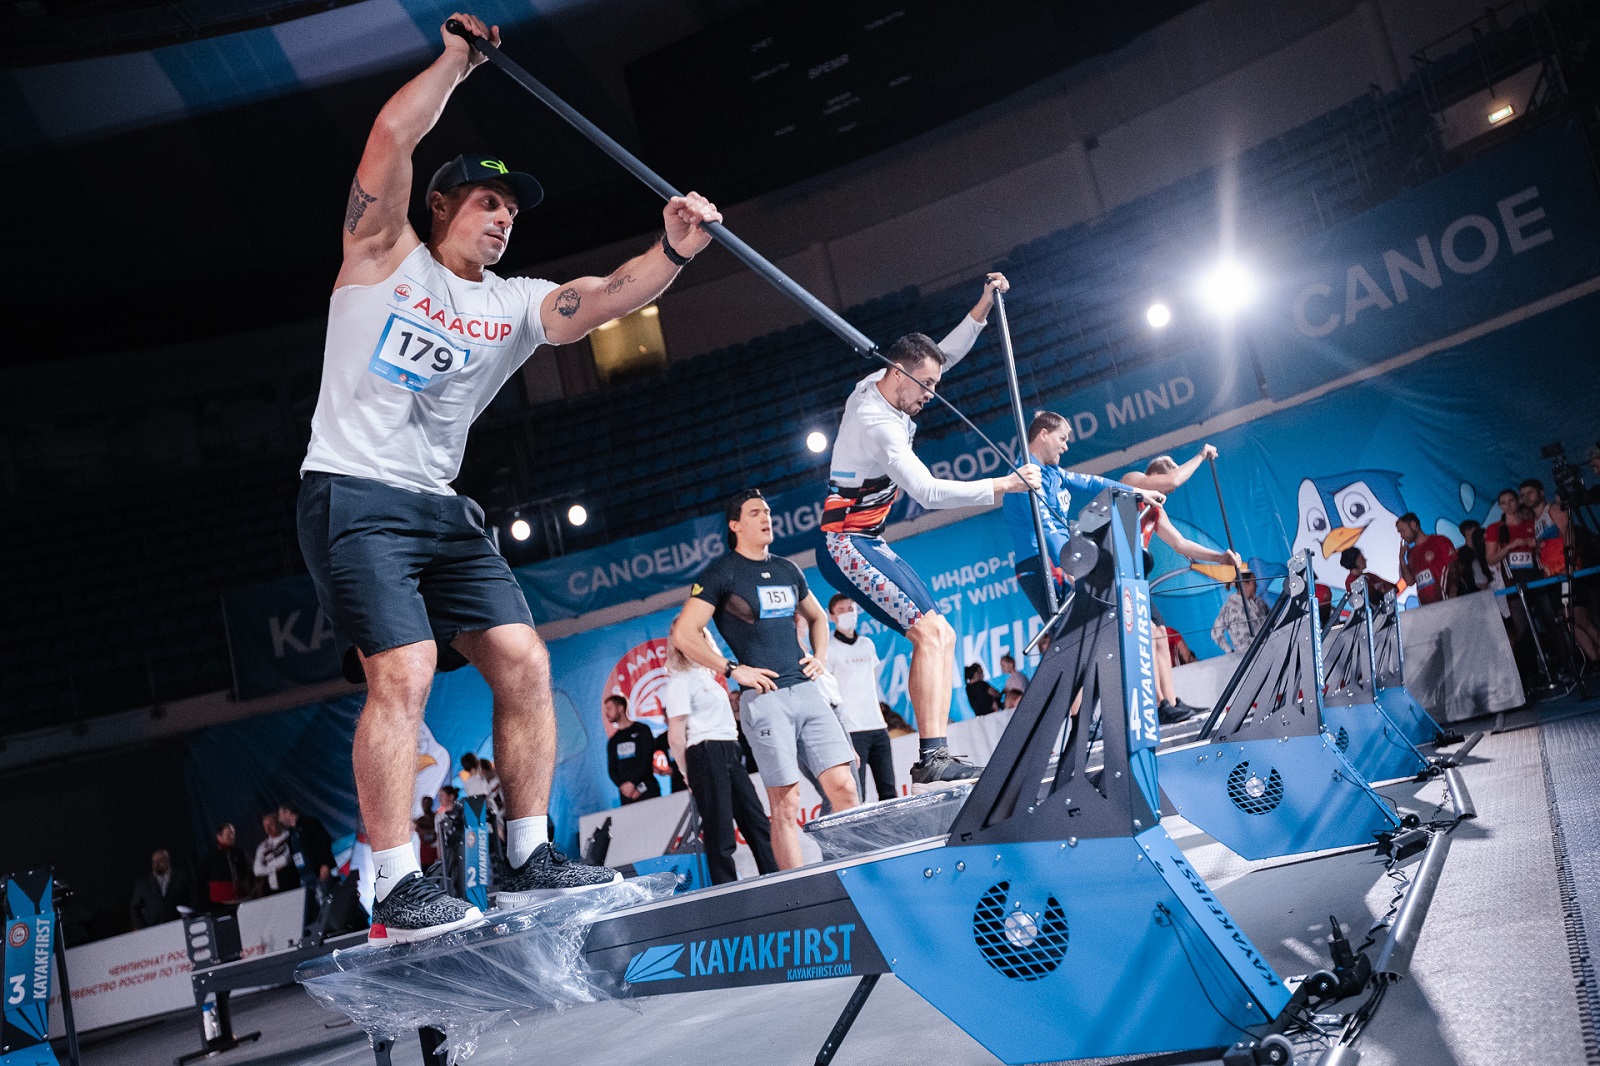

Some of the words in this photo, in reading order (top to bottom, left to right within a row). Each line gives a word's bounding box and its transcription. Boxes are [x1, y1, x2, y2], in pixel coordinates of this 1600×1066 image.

[1294, 185, 1554, 338] CANOE
[413, 297, 512, 342] AAACUP
[399, 331, 454, 373] 179
[567, 532, 725, 596] CANOEING
[931, 438, 1019, 482] BODY
[1106, 376, 1195, 429] MIND
[766, 591, 788, 604] 151
[967, 576, 1019, 606] WINT
[268, 606, 336, 658] KA
[626, 645, 666, 675] AAAC
[1135, 586, 1157, 741] KAYAKFIRST
[1130, 688, 1142, 741] 4
[467, 866, 477, 888] 2
[1170, 856, 1279, 987] KAYAKFIRST
[33, 918, 50, 999] KAYAKFIRST
[167, 949, 189, 966] РОС
[690, 924, 855, 977] KAYAKFIRST
[787, 963, 852, 981] KAYAKFIRST.COM
[8, 973, 26, 1005] 3
